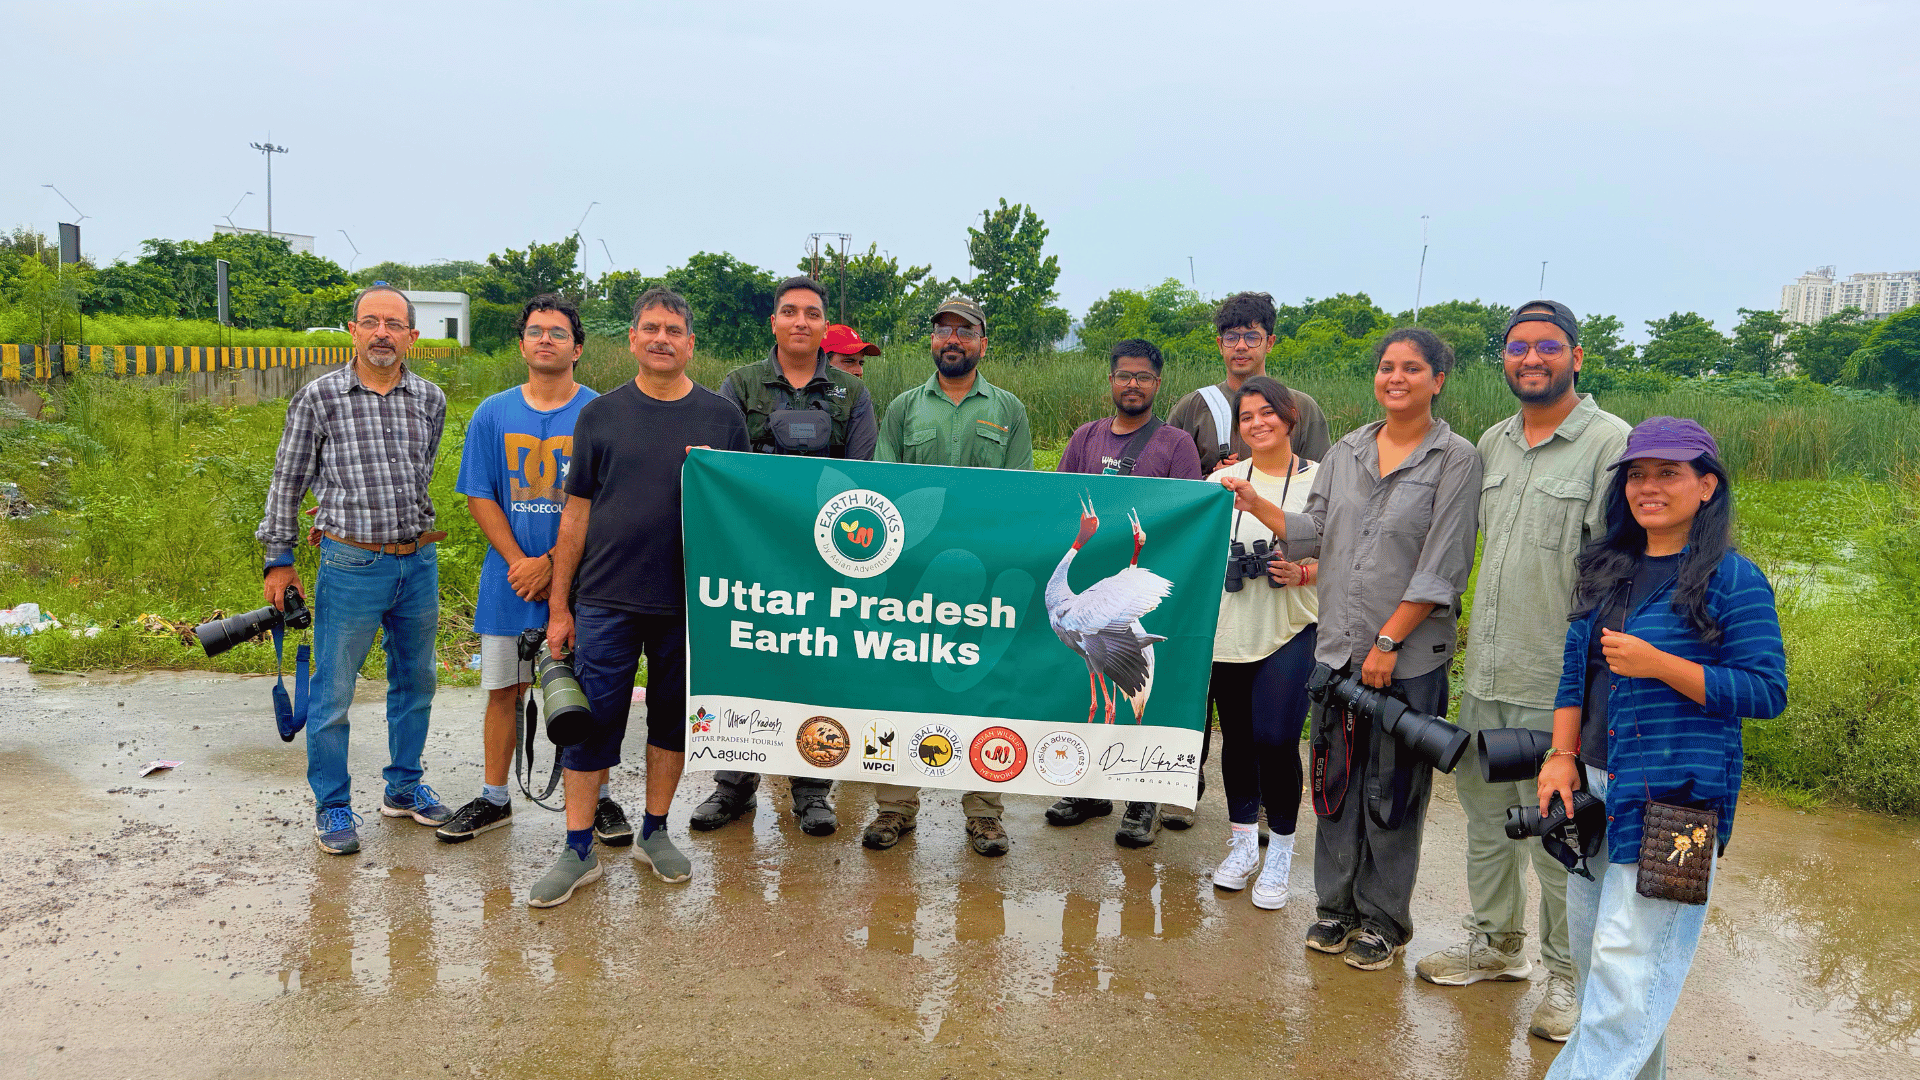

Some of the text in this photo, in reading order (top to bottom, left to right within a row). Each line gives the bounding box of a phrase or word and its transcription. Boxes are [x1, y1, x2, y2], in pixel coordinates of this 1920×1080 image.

[820, 494, 900, 533] EARTH WALKS
[823, 543, 896, 573] by Asian Adventures
[699, 576, 1016, 628] Uttar Pradesh
[730, 620, 980, 665] Earth Walks
[716, 736, 749, 744] PRADESH
[751, 738, 784, 747] TOURISM
[910, 725, 962, 760] GLOBAL WILDLIFE
[974, 730, 1023, 751] INDIAN WILDLIFE
[1039, 735, 1084, 766] asian adventures
[689, 746, 767, 762] Magucho
[863, 761, 895, 772] WPCI
[924, 766, 946, 776] FAIR
[980, 768, 1015, 779] NETWORK
